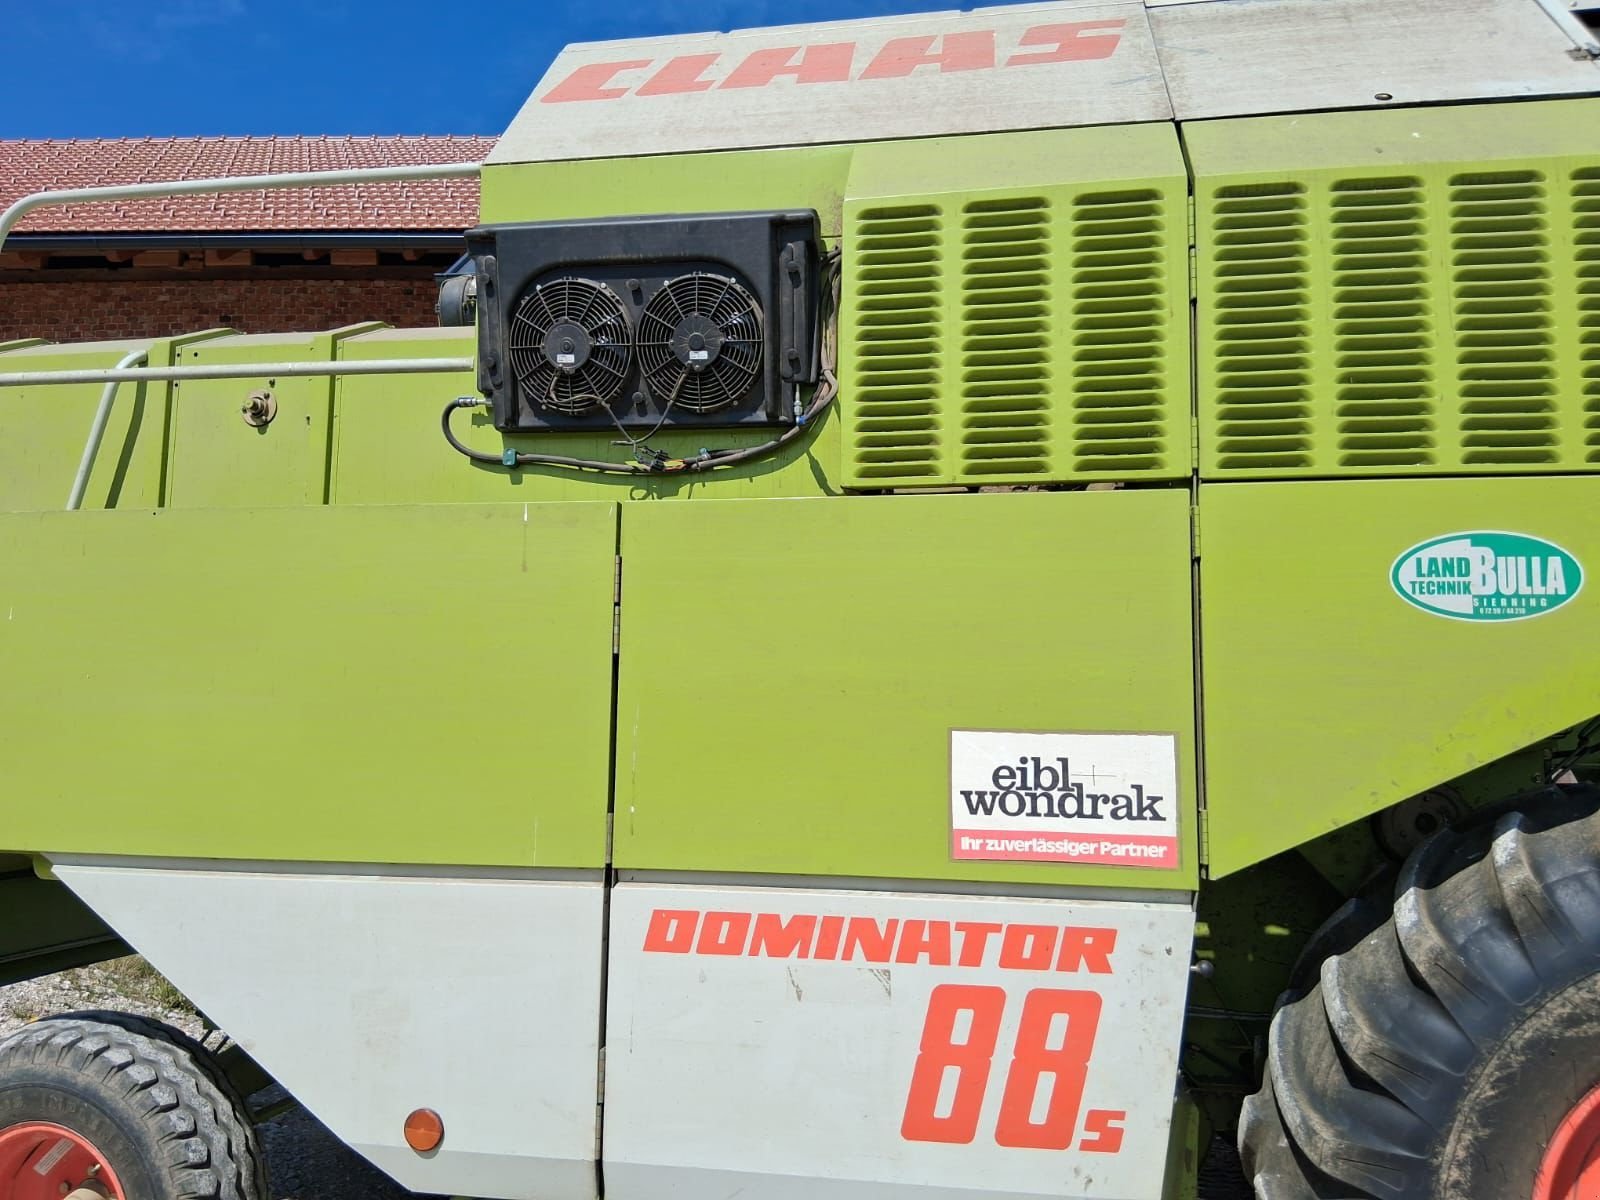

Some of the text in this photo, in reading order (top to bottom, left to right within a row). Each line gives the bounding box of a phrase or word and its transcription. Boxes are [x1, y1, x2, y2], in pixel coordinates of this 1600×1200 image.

[540, 19, 1127, 104] CLAAS
[1415, 557, 1471, 578] LAND
[1471, 546, 1567, 596] BULLA
[1410, 580, 1472, 595] TECHNIK
[1473, 597, 1547, 607] SIERNING
[992, 756, 1075, 792] eibl
[960, 783, 1167, 822] wondrak
[960, 836, 1167, 858] Ihr zuverlässiger Partner
[643, 909, 1118, 974] DOMINATOR
